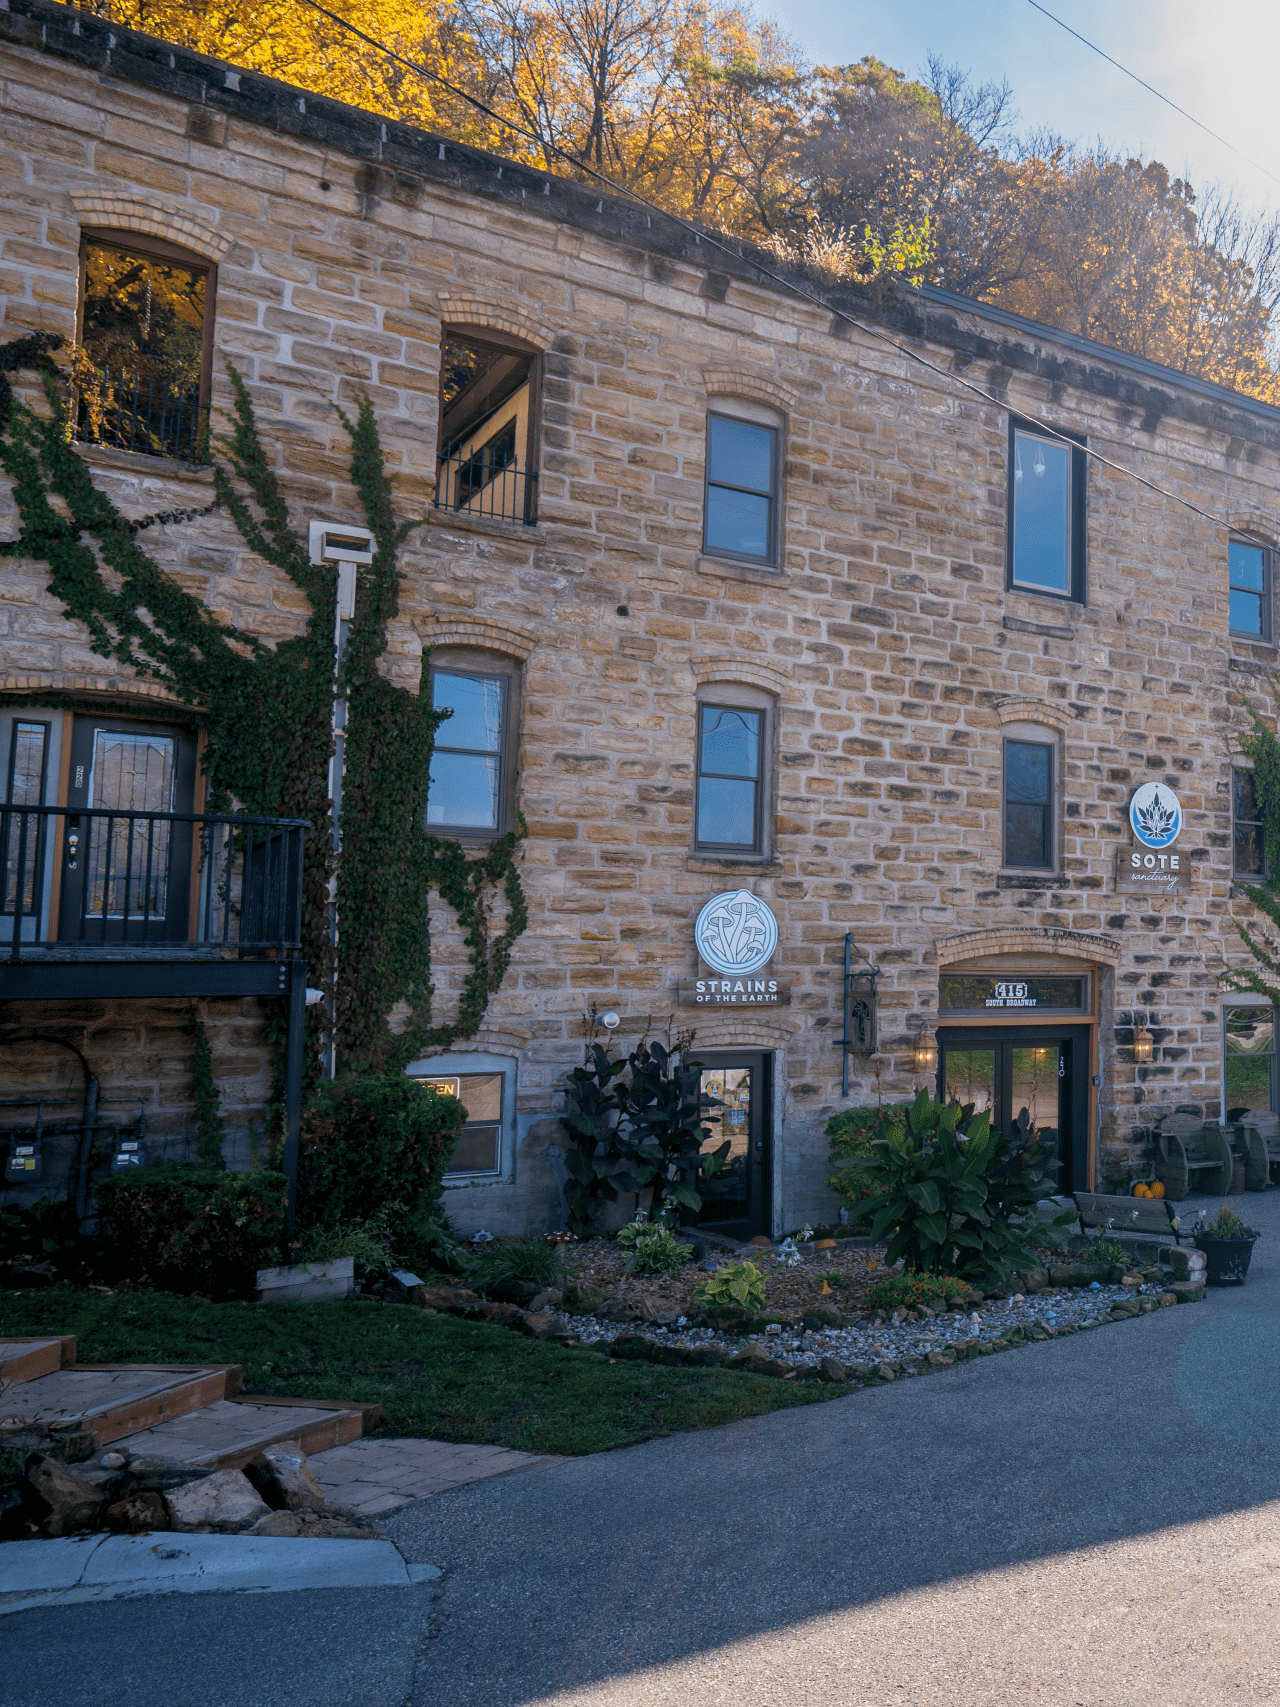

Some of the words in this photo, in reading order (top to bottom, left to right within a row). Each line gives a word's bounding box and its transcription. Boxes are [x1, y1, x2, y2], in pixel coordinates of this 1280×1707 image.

[76, 766, 84, 787] 220
[1131, 853, 1179, 869] SOTE
[1131, 868, 1179, 890] sanctuary
[695, 980, 778, 992] STRAINS
[998, 984, 1024, 997] 415
[741, 994, 778, 1002] EARTH
[985, 999, 1004, 1007] SOUTH
[1006, 998, 1037, 1007] BROADWAY
